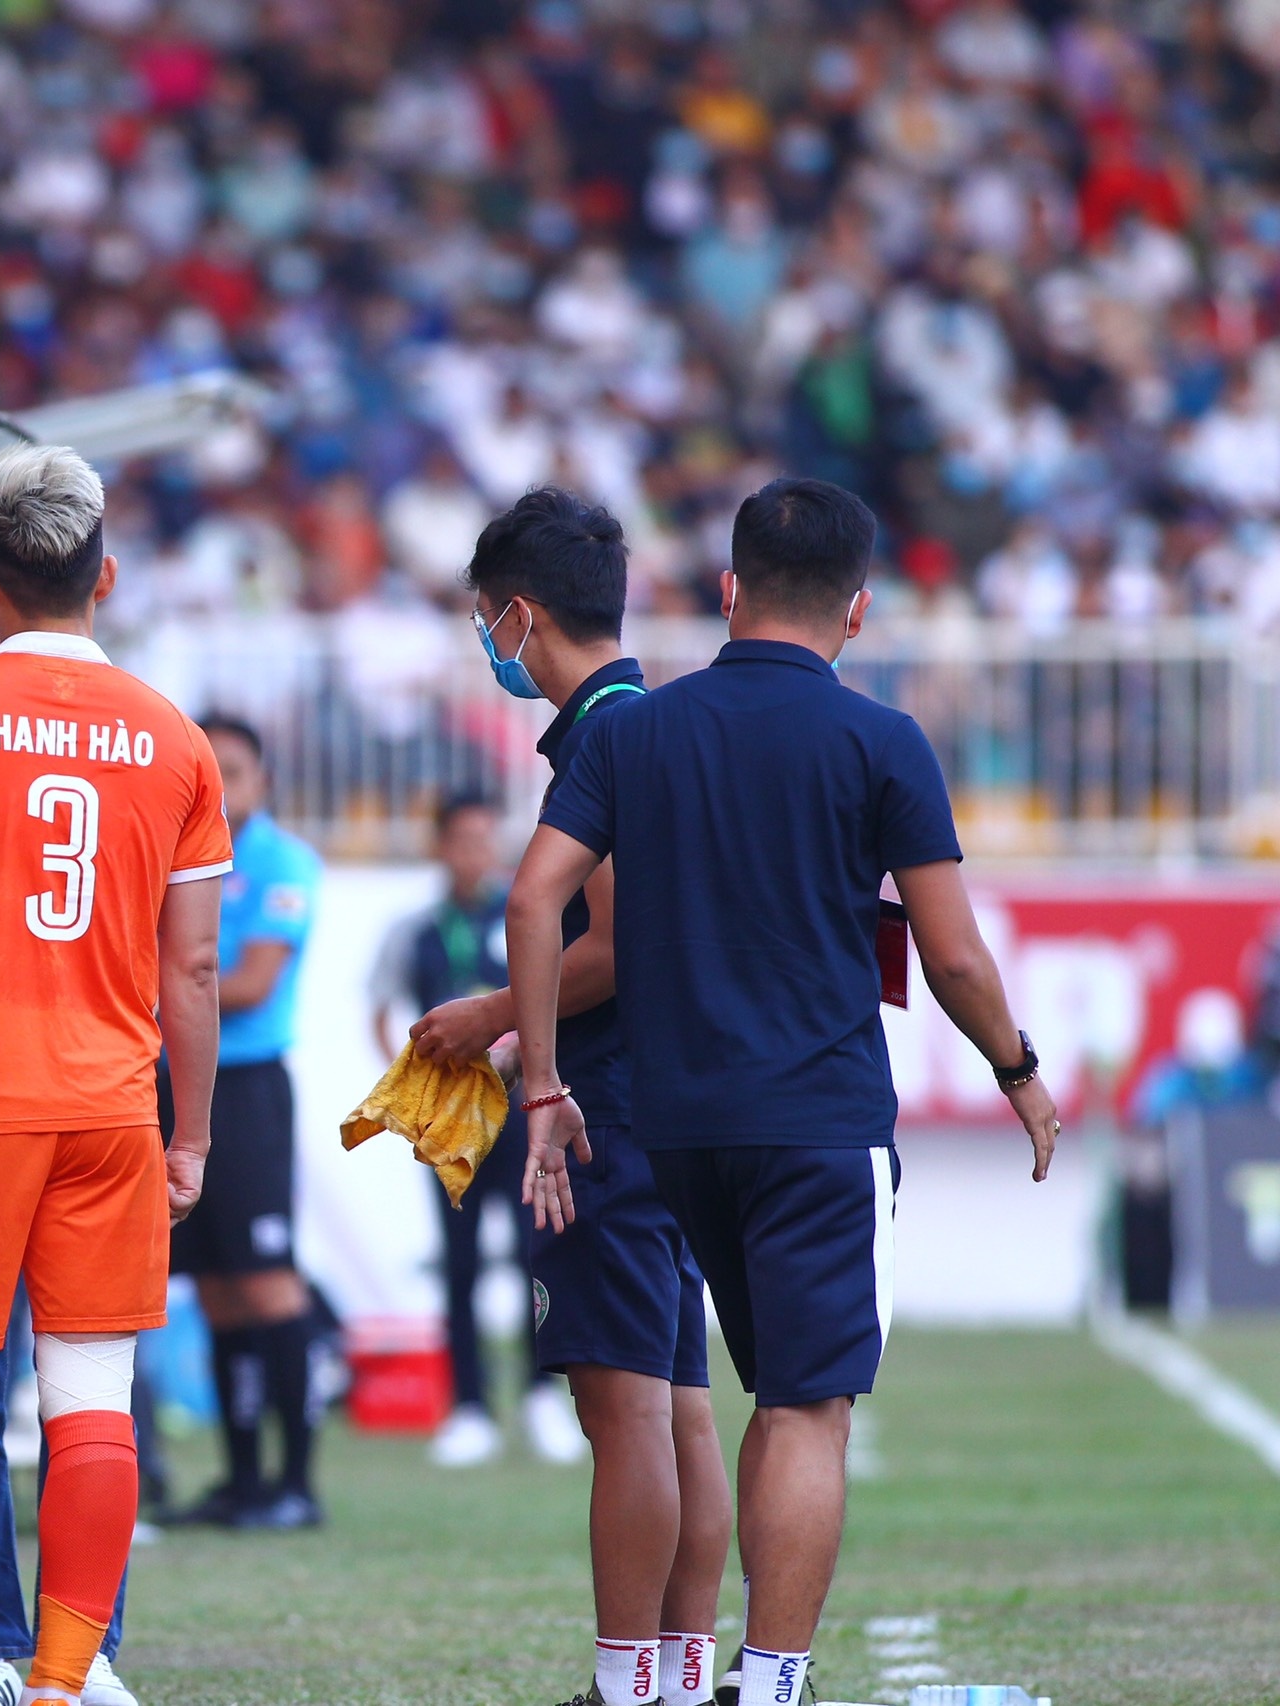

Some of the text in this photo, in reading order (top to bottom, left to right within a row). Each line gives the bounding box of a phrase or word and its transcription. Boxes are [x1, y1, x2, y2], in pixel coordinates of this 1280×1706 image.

[87, 718, 154, 767] HÀO
[25, 773, 100, 942] 3
[633, 1647, 655, 1698] KAMITO
[682, 1637, 704, 1691] KAMITO
[774, 1657, 800, 1704] KAMITO
